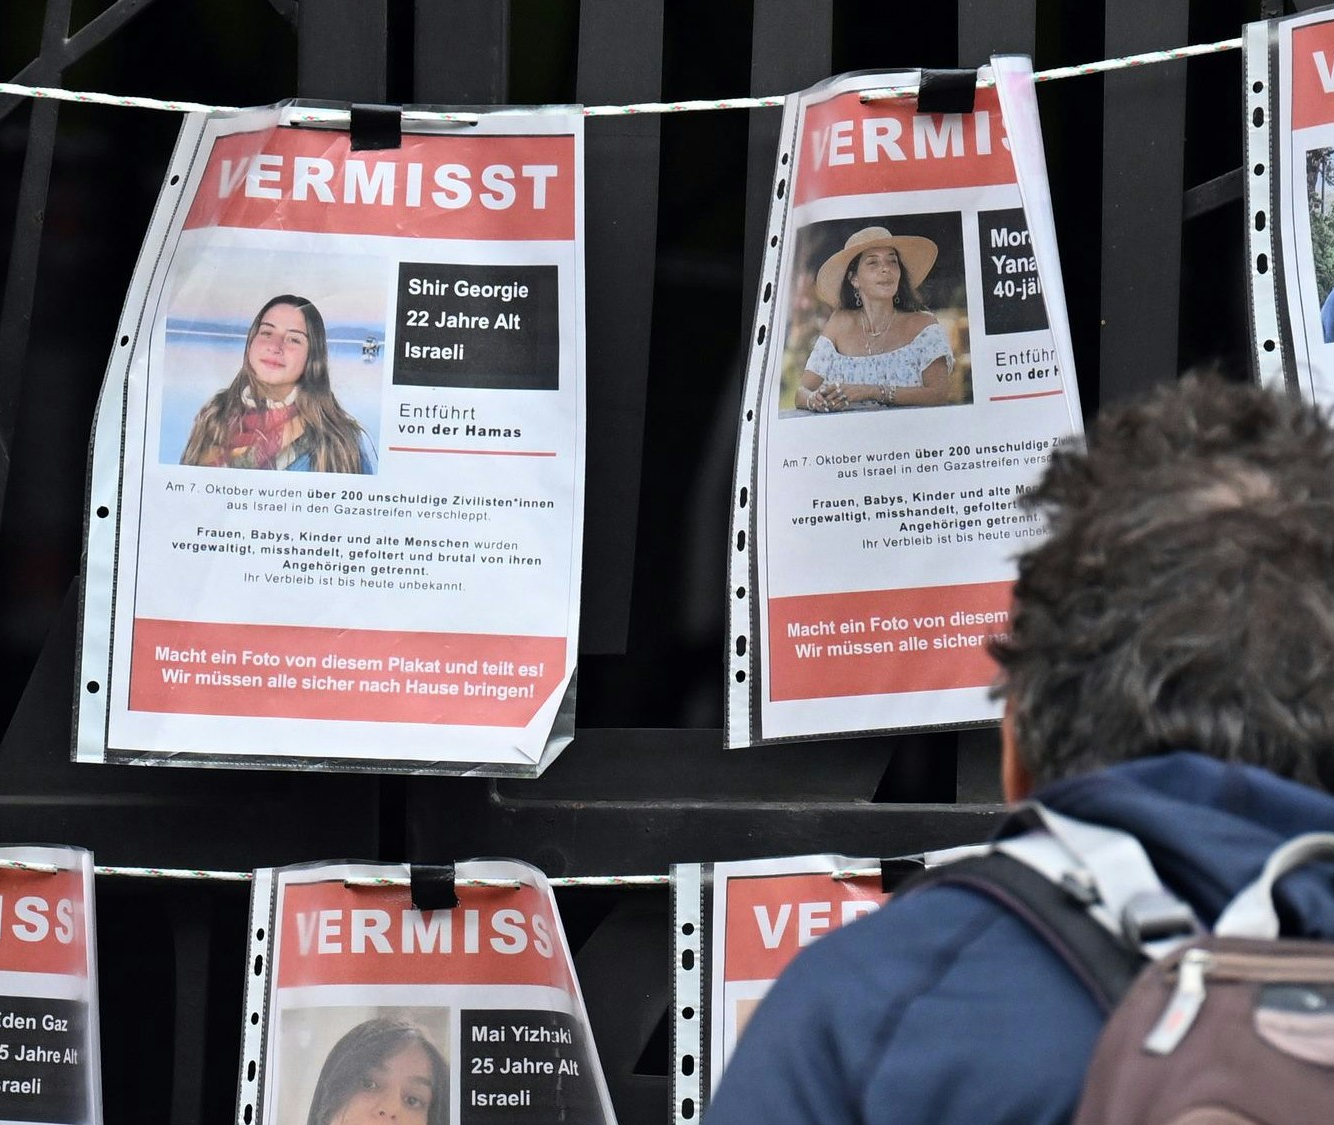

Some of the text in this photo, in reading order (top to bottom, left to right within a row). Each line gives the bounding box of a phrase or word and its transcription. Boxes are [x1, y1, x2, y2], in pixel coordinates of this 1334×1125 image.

[813, 111, 1013, 171] VERMI
[217, 155, 557, 210] VERMISST
[407, 277, 529, 302] Shir Georgie
[406, 309, 521, 330] 22 Jahre Alt
[403, 340, 464, 361] Israeli
[398, 401, 476, 421] Entführt
[397, 422, 522, 438] von der Hamas
[225, 500, 492, 523] aus Israel in den Gazastreifen verschleppt.
[296, 909, 553, 958] VERMISS
[470, 1024, 505, 1042] Mai
[13, 1043, 61, 1064] Jahre
[61, 1046, 78, 1065] Alt
[470, 1056, 580, 1076] 25 Jahre Alt
[470, 1088, 530, 1106] Israeli
